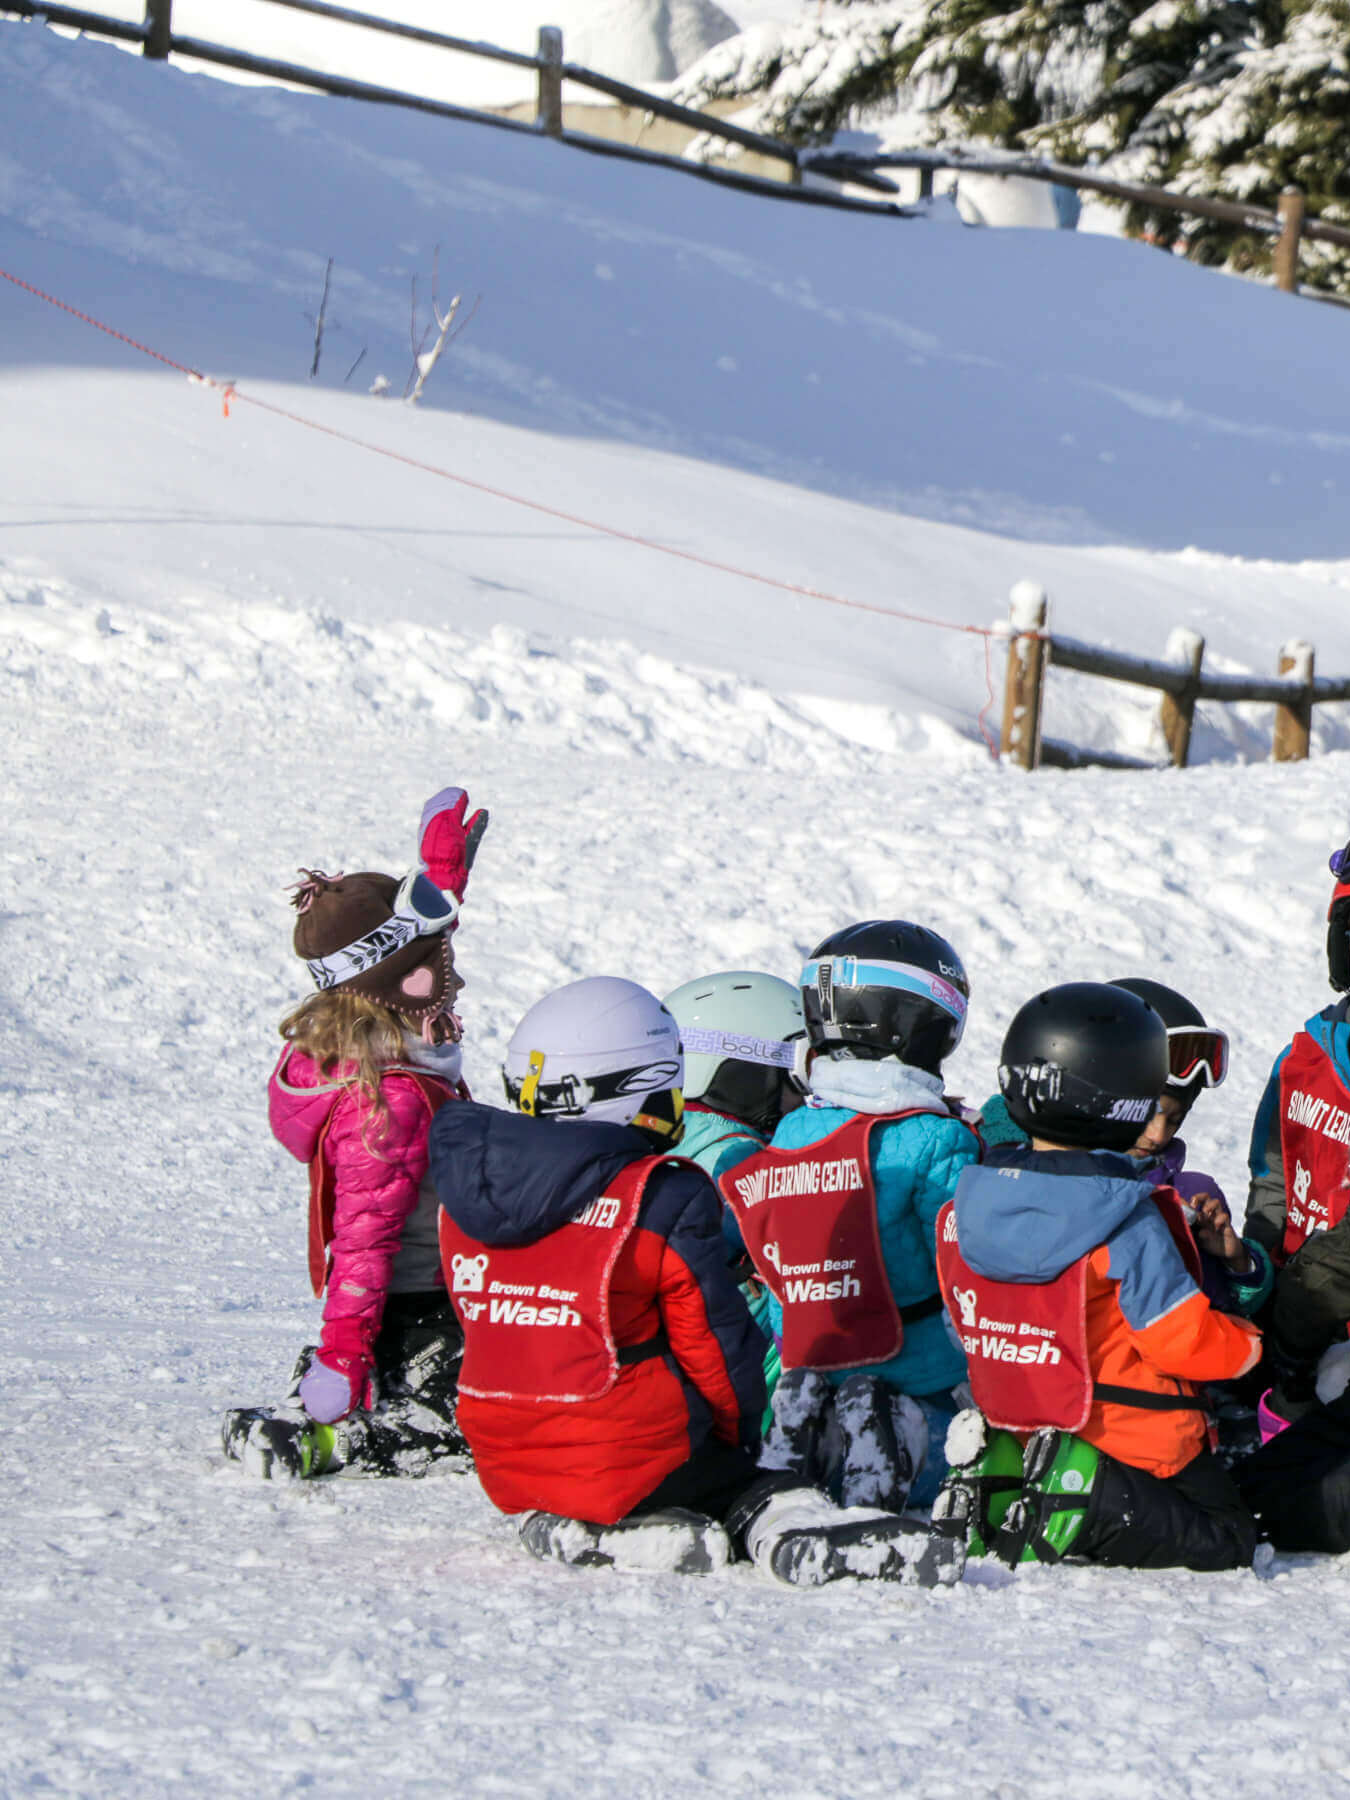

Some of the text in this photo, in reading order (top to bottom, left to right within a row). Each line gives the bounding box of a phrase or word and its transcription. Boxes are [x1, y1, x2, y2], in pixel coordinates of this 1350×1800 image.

[1105, 1098, 1153, 1122] SMITH
[1287, 1089, 1330, 1131] SUMMIT
[768, 1160, 821, 1199] LEARNING
[1288, 1206, 1305, 1227] ar
[1307, 1200, 1328, 1216] Bro
[781, 1259, 856, 1276] Brown Bear
[488, 1280, 578, 1301] Brown Bear
[785, 1274, 861, 1303] Wash
[489, 1299, 582, 1326] Wash
[978, 1317, 1056, 1338] Brown Bear
[964, 1335, 1062, 1365] ar Wash
